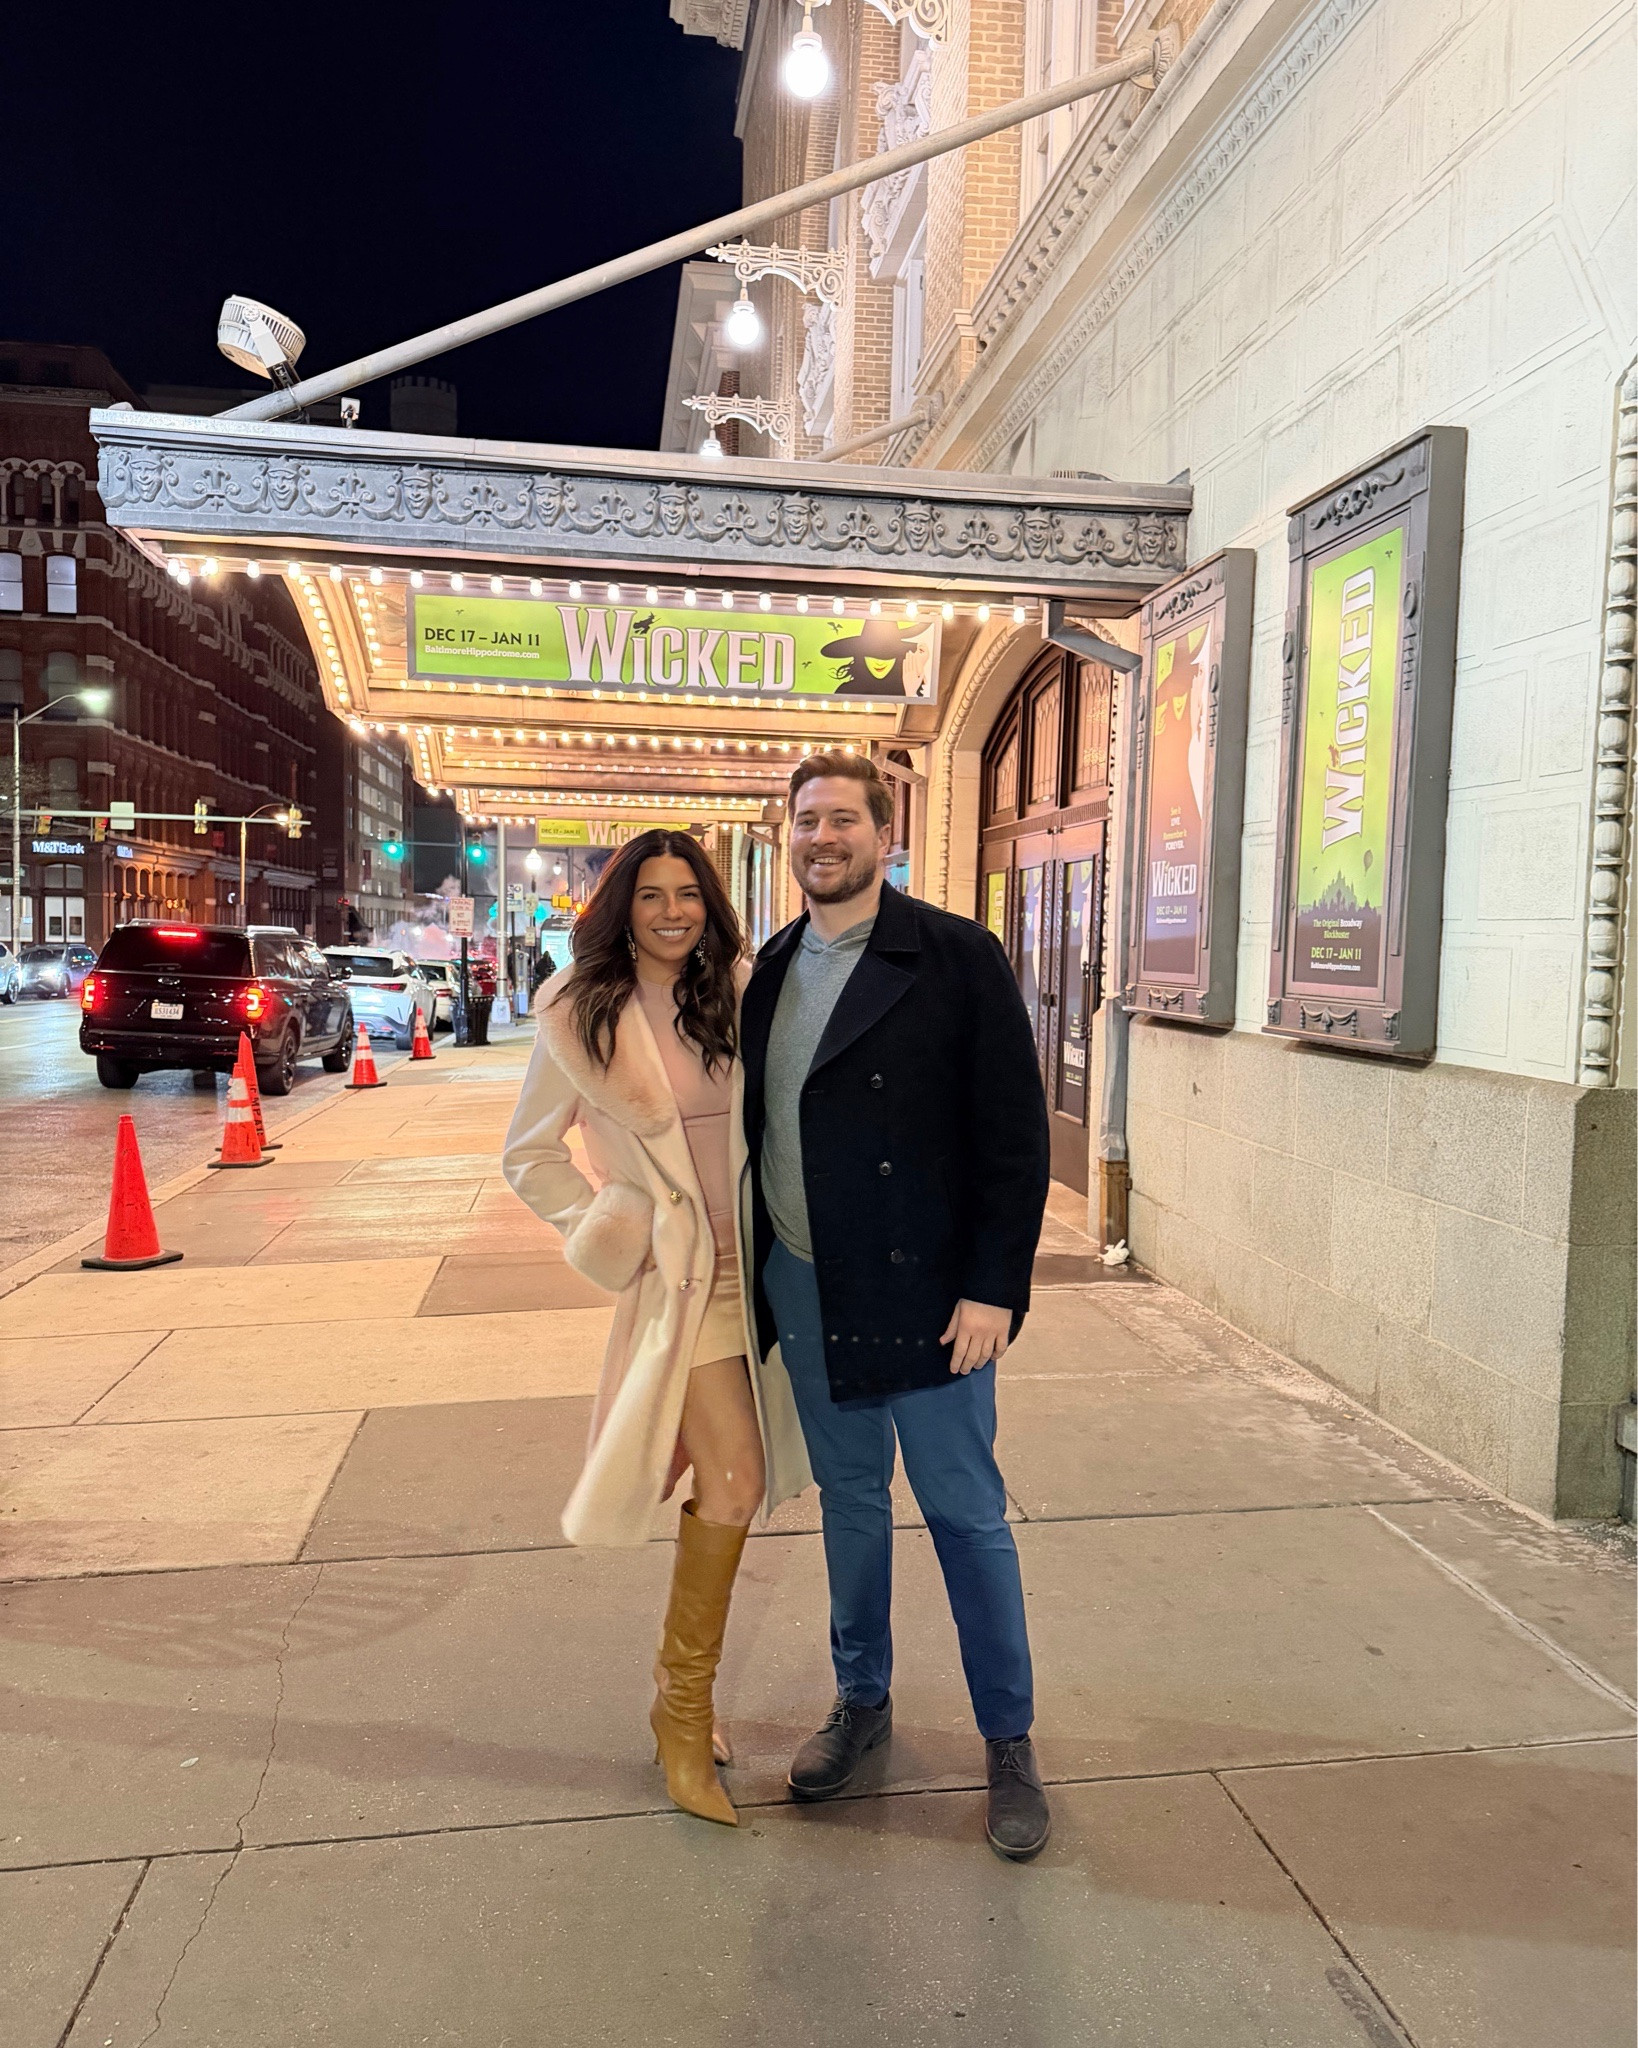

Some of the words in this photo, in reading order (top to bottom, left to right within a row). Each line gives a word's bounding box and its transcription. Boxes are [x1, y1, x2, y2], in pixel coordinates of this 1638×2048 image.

[424, 628, 455, 643] DEC
[460, 629, 476, 643] 17
[491, 631, 522, 646] JAN
[527, 633, 540, 647] 11
[424, 644, 540, 660] BaltimoreHippodrome.com
[32, 841, 59, 853] M&T
[60, 843, 85, 854] Bank
[1313, 919, 1322, 928] The
[1322, 919, 1339, 929] Original
[1340, 918, 1363, 929] Broadway
[1323, 930, 1350, 939] Blockbuster
[1311, 946, 1325, 959] DEC
[1326, 947, 1333, 958] 17
[1338, 947, 1353, 960] JAN
[1355, 948, 1361, 960] 11
